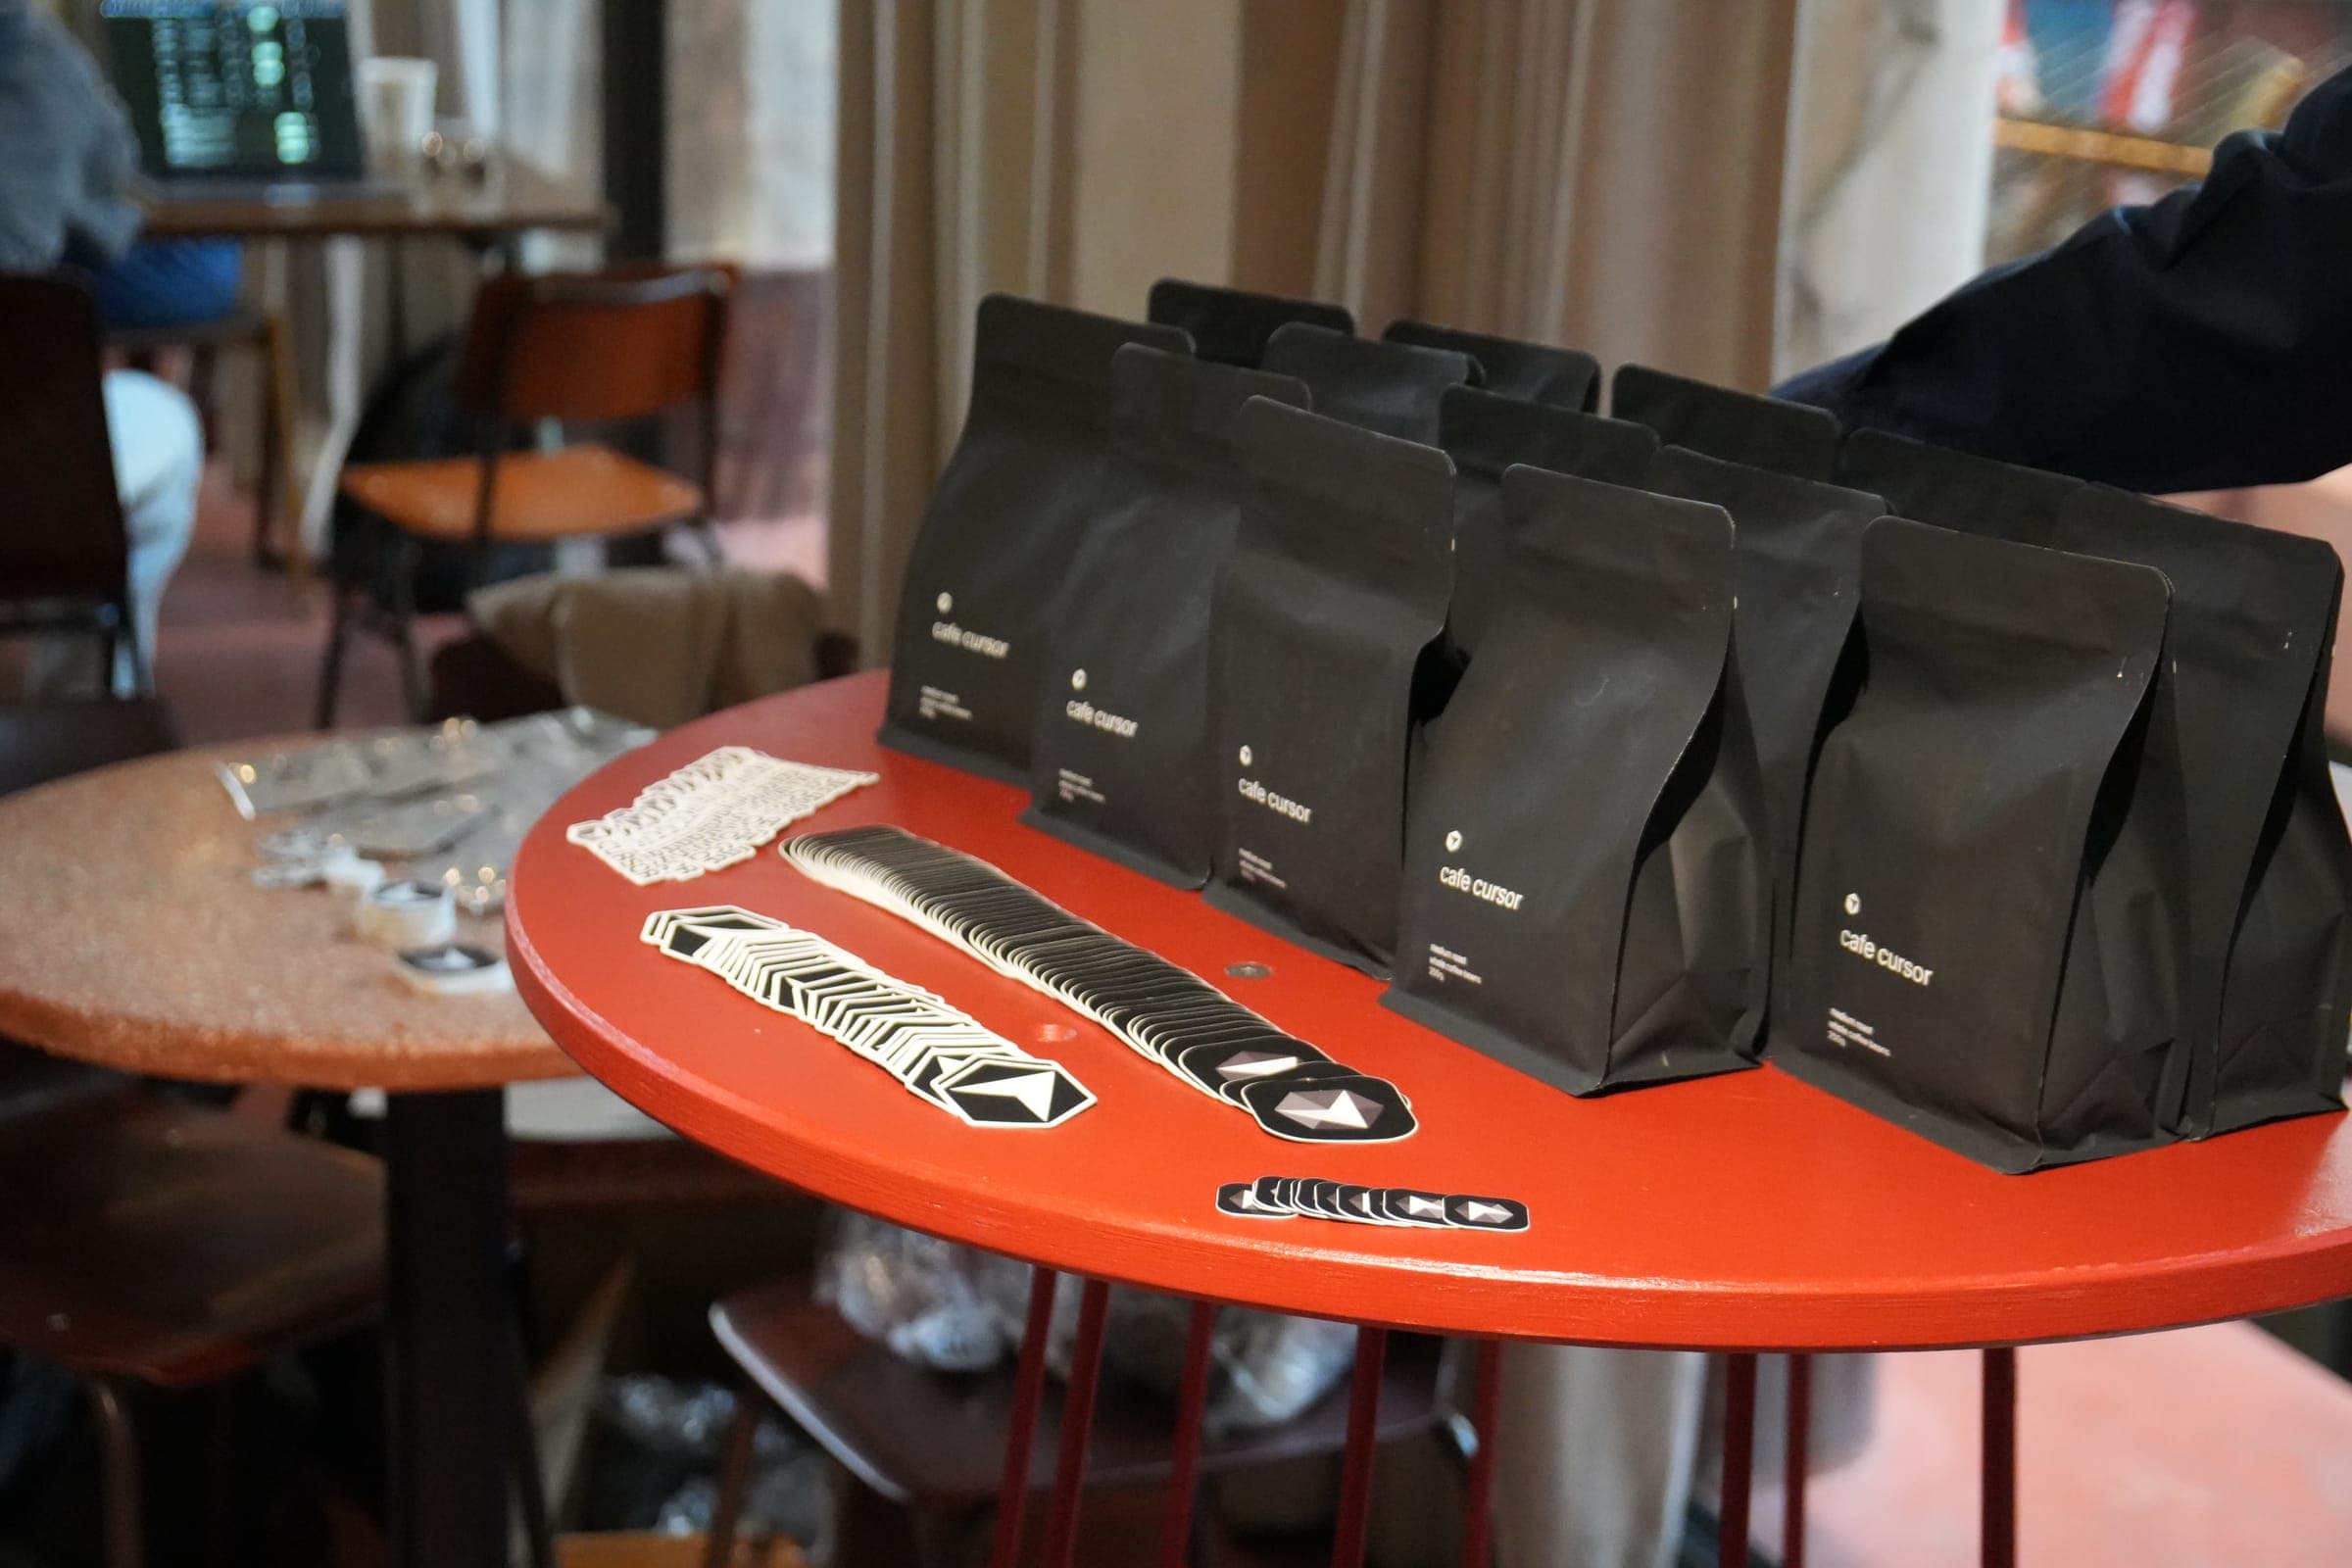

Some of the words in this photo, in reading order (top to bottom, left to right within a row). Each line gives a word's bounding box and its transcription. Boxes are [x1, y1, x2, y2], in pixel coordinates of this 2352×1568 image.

[932, 621, 961, 646] cafe
[962, 630, 1010, 659] cursor
[1066, 700, 1095, 725] cafe
[1095, 710, 1138, 737] cursor
[1238, 778, 1266, 804] cafe
[1268, 792, 1311, 822] cursor
[1440, 866, 1471, 892] cafe
[1472, 878, 1524, 910] cursor
[1839, 930, 1876, 959] cafe
[1877, 948, 1934, 986] cursor
